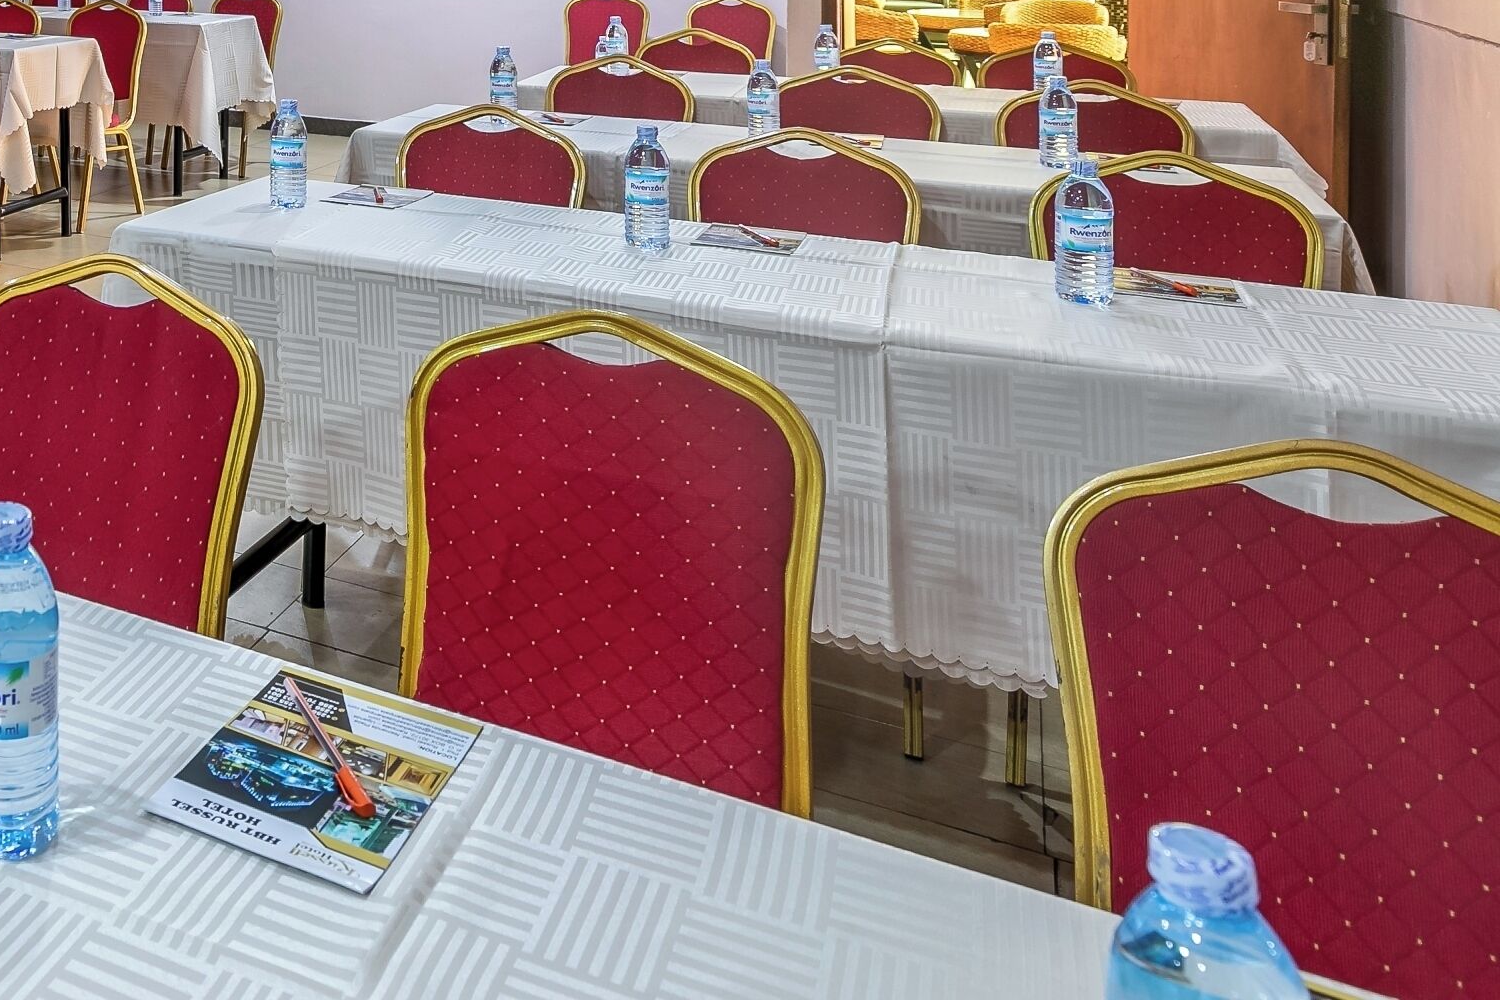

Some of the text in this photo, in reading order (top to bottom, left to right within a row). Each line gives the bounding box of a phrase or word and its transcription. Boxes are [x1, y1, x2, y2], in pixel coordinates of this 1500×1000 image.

[4, 722, 20, 736] ml
[171, 798, 283, 847] HBT RUSSEL
[202, 798, 263, 827] HOTEL
